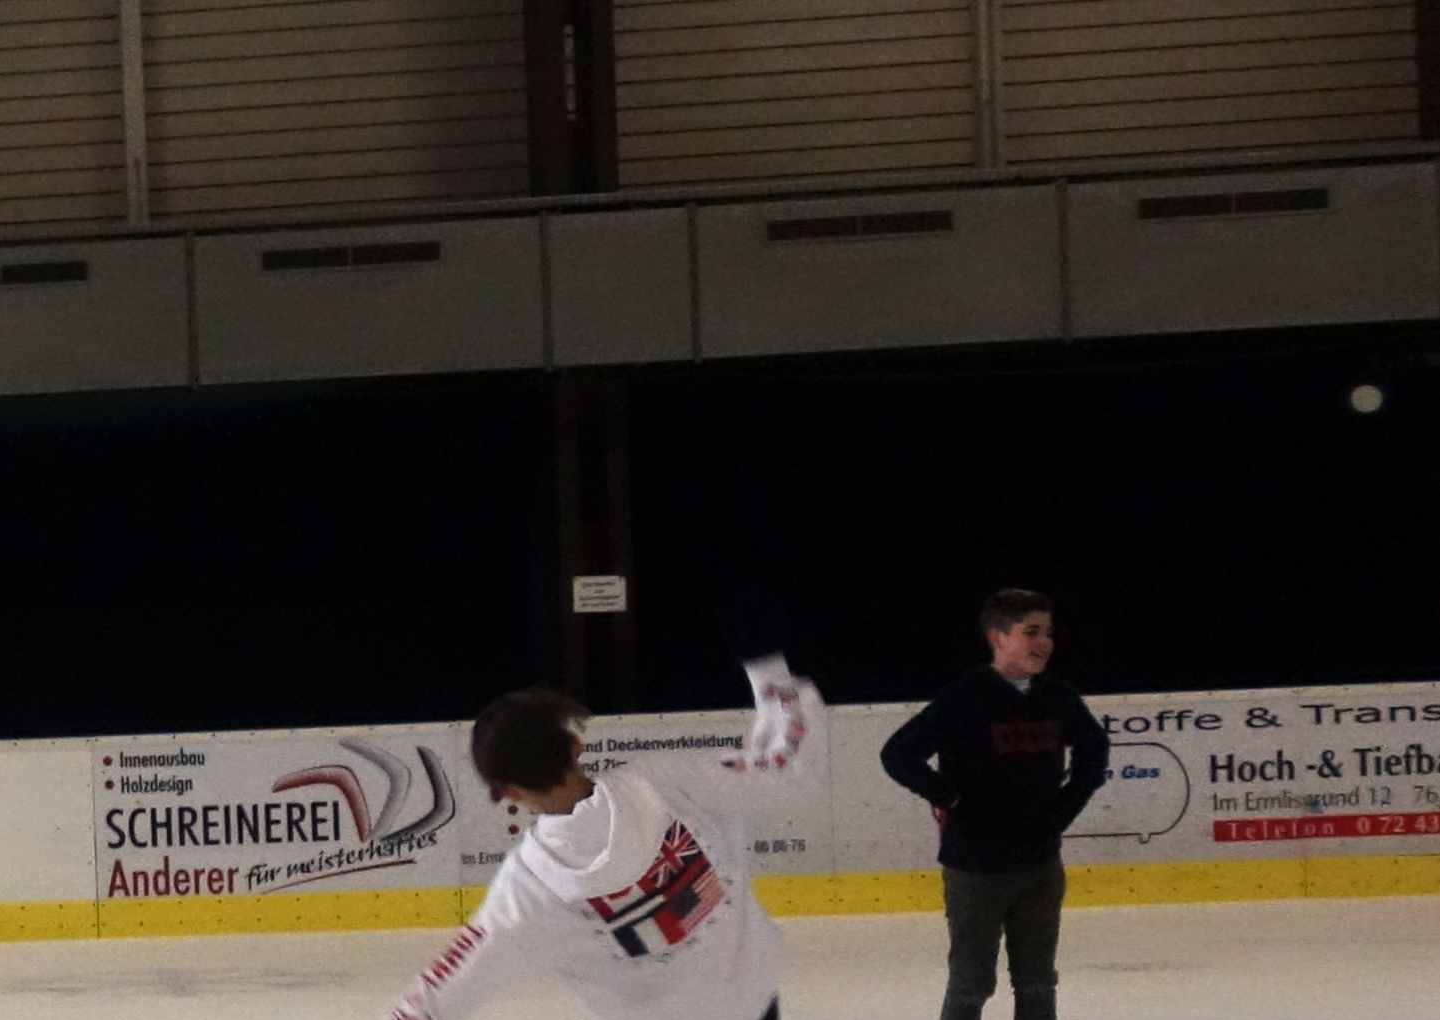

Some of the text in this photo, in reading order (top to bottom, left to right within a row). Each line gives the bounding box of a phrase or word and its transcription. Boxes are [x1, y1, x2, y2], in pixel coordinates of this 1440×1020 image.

[1245, 707, 1281, 728] &
[607, 735, 743, 752] Deckenverkleidung
[119, 749, 205, 769] Innenausbau
[1209, 749, 1295, 783] Hoch
[1121, 764, 1160, 780] Gas
[120, 776, 193, 795] Holzdesign
[105, 800, 341, 850] SCHREINEREI
[108, 856, 239, 898] Anderer
[245, 863, 282, 890] für
